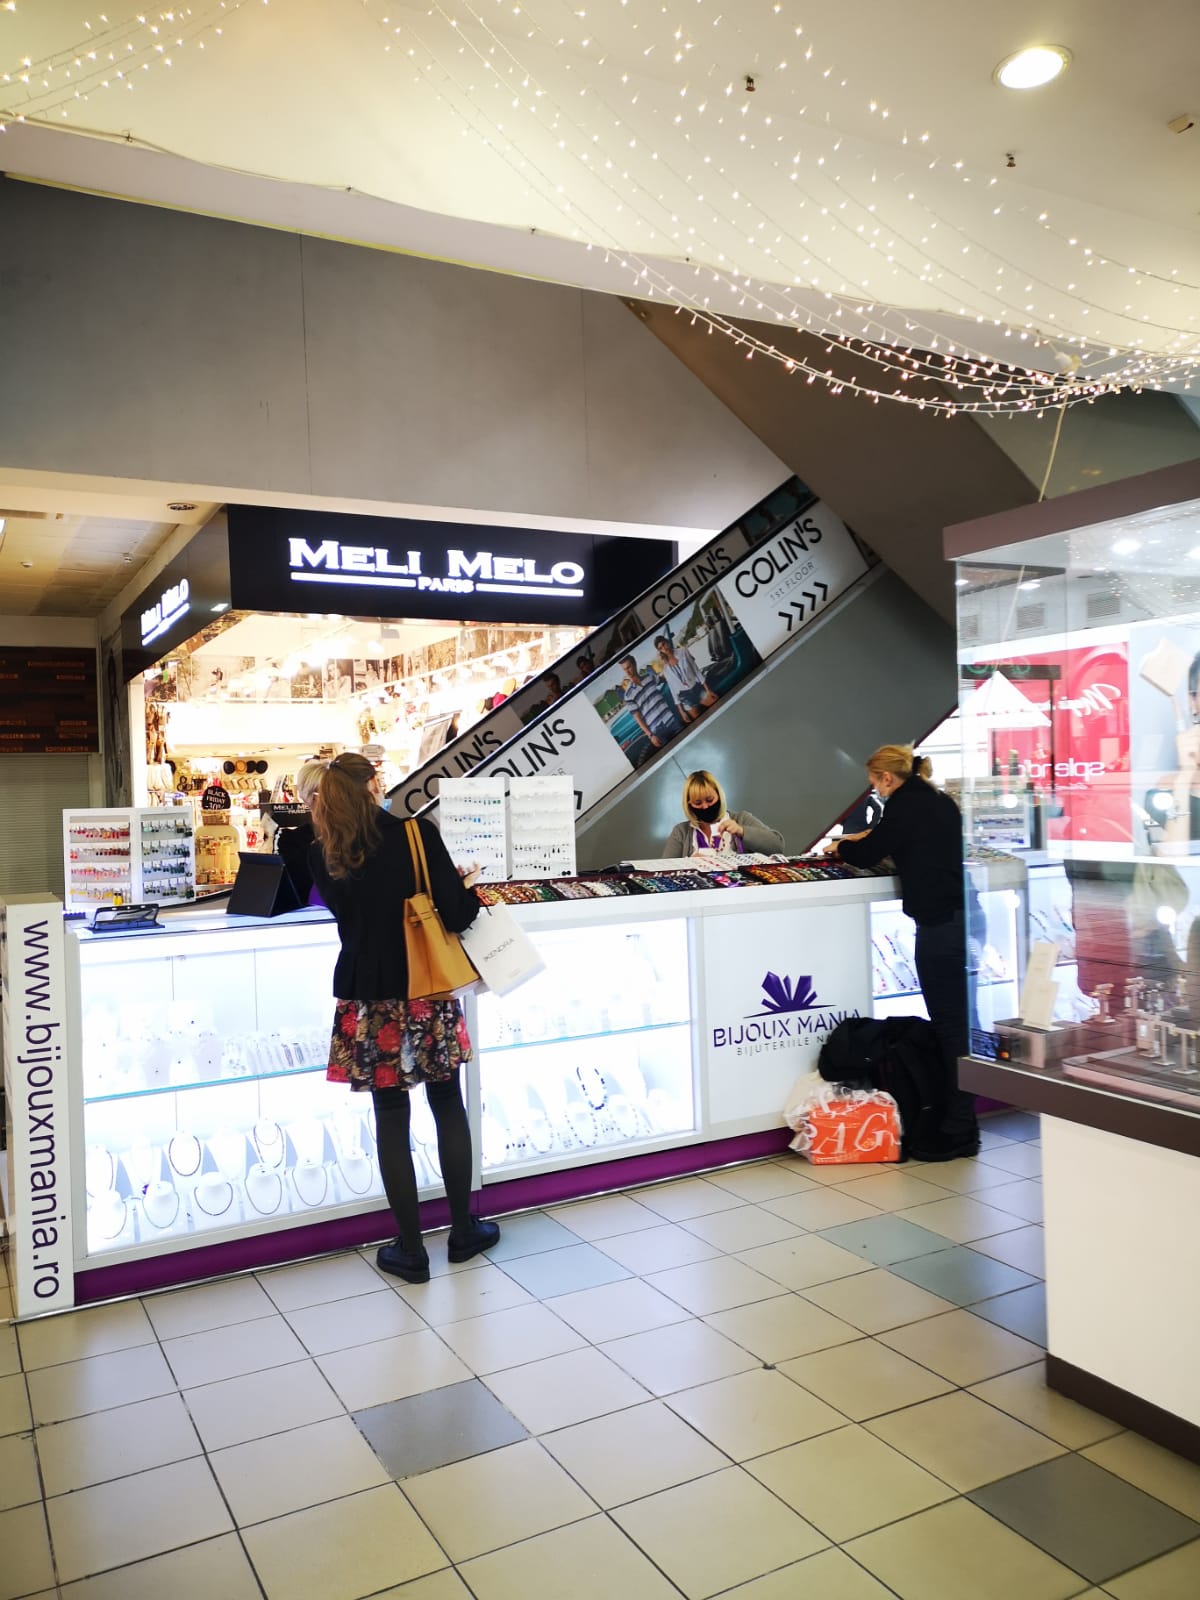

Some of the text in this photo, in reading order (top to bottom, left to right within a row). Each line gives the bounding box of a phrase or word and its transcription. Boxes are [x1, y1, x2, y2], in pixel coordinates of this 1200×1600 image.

[288, 537, 585, 585] MELI MELO
[735, 518, 822, 598] COLIN'S
[418, 576, 475, 594] PARIS
[652, 547, 733, 619] COLIN'S
[770, 561, 816, 602] 1st FLOOR
[489, 718, 576, 777] LIN'S
[207, 788, 226, 798] BLACK
[404, 730, 503, 815] COLIN'S
[206, 795, 226, 805] FRIDAY
[713, 1017, 791, 1048] BIJOUX
[736, 1036, 810, 1057] BIJUTERIILE
[17, 919, 67, 1300] www.bijouxmania.ro
